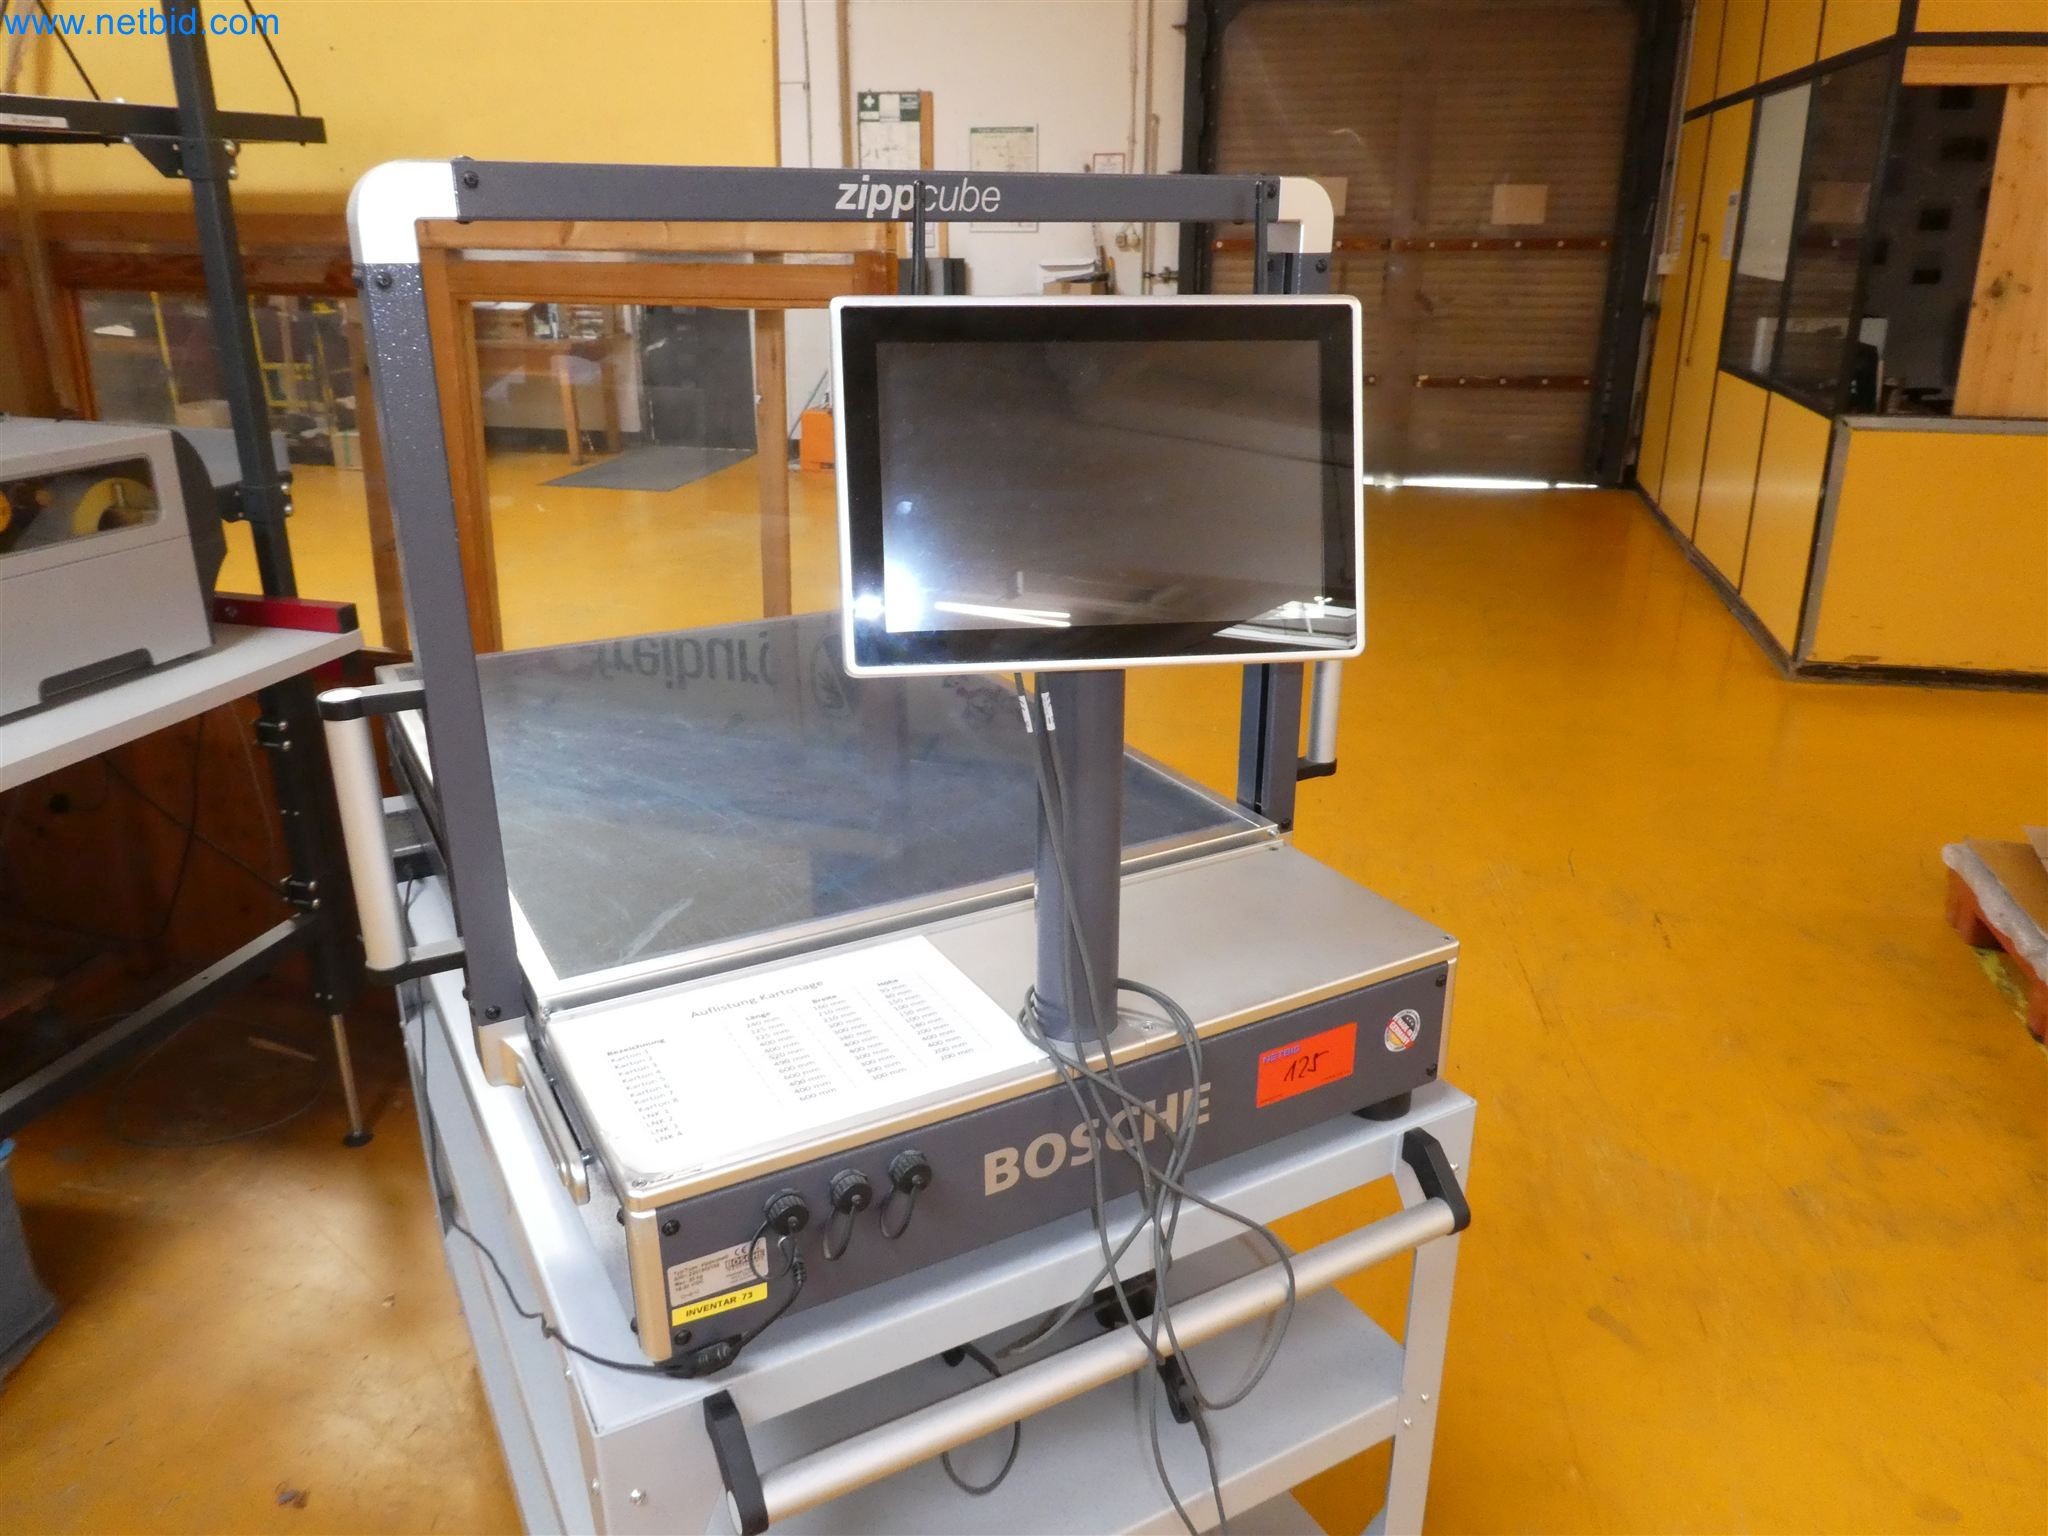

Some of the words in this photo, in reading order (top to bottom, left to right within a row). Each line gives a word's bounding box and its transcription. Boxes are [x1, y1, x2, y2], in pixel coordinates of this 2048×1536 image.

[835, 174, 1001, 219] zippcube
[691, 997, 757, 1018] Auflistung
[759, 980, 824, 1002] Kartonage
[1283, 1050, 1329, 1082] 125
[983, 1082, 1211, 1197] BOSCHE
[686, 1296, 737, 1317] INVENTAR
[742, 1291, 753, 1301] 73
